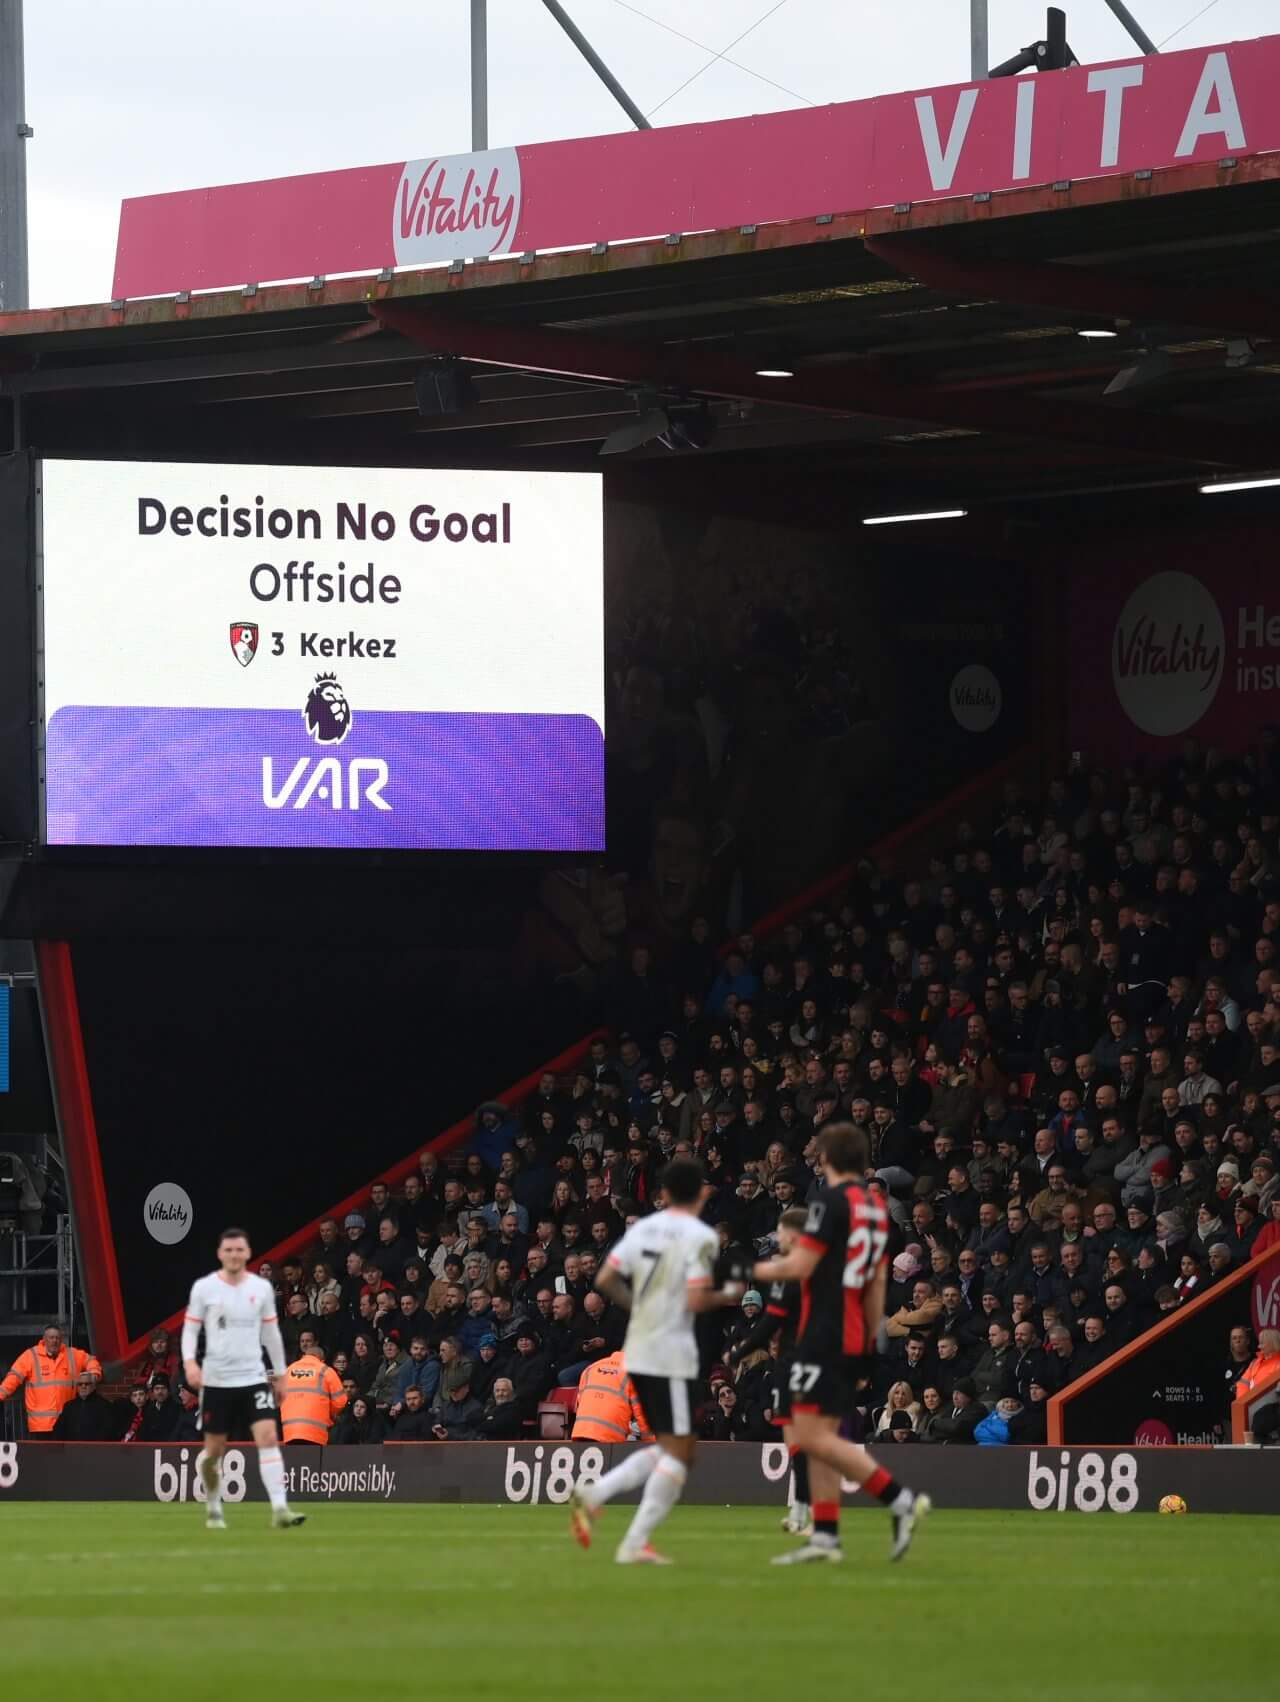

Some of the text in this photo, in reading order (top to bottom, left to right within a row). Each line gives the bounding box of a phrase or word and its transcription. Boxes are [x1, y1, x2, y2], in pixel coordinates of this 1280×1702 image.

[914, 52, 1247, 191] VITA
[400, 160, 515, 253] Vitality
[138, 495, 511, 544] Decision No Goal
[249, 561, 402, 604] Offside
[271, 632, 397, 658] 3 Kerkez
[1118, 616, 1221, 691] Vitality
[262, 756, 393, 810] VAR
[148, 1199, 188, 1228] Vitality
[639, 1249, 662, 1297] 7
[842, 1226, 889, 1288] 27
[788, 1361, 822, 1392] 27
[300, 1464, 397, 1498] Responsibly.
